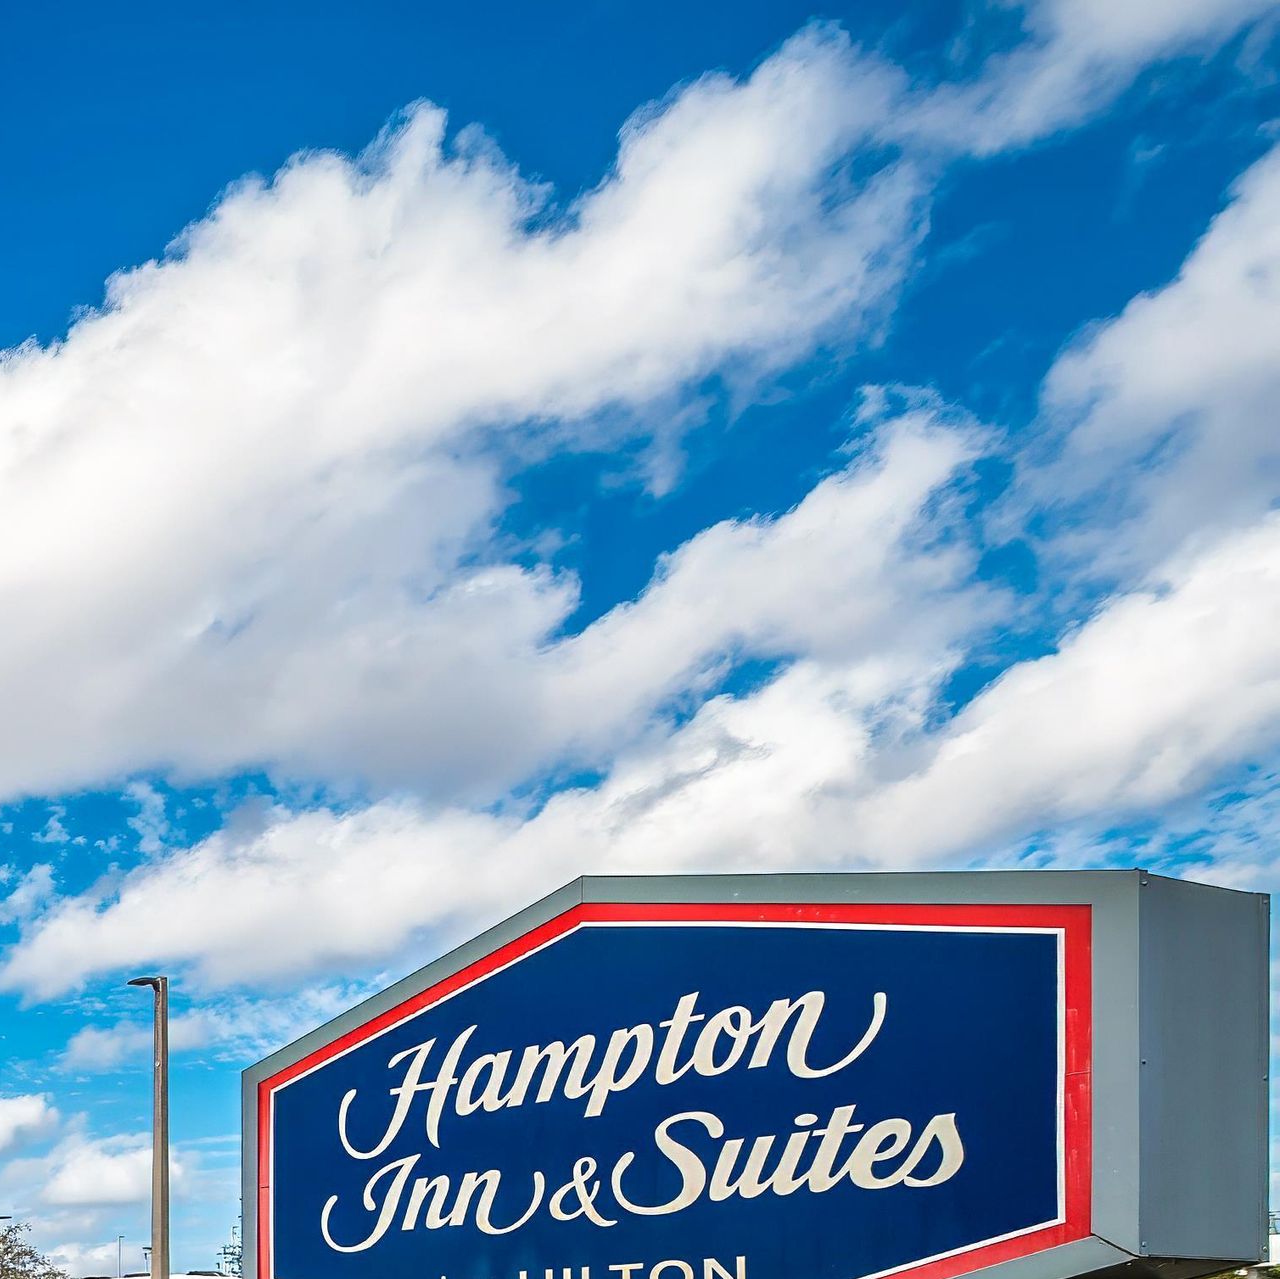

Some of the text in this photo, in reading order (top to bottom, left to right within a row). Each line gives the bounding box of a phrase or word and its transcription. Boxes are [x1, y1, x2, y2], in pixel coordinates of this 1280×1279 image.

[338, 990, 887, 1160] Hampton
[320, 1104, 965, 1253] Inn & Suites
